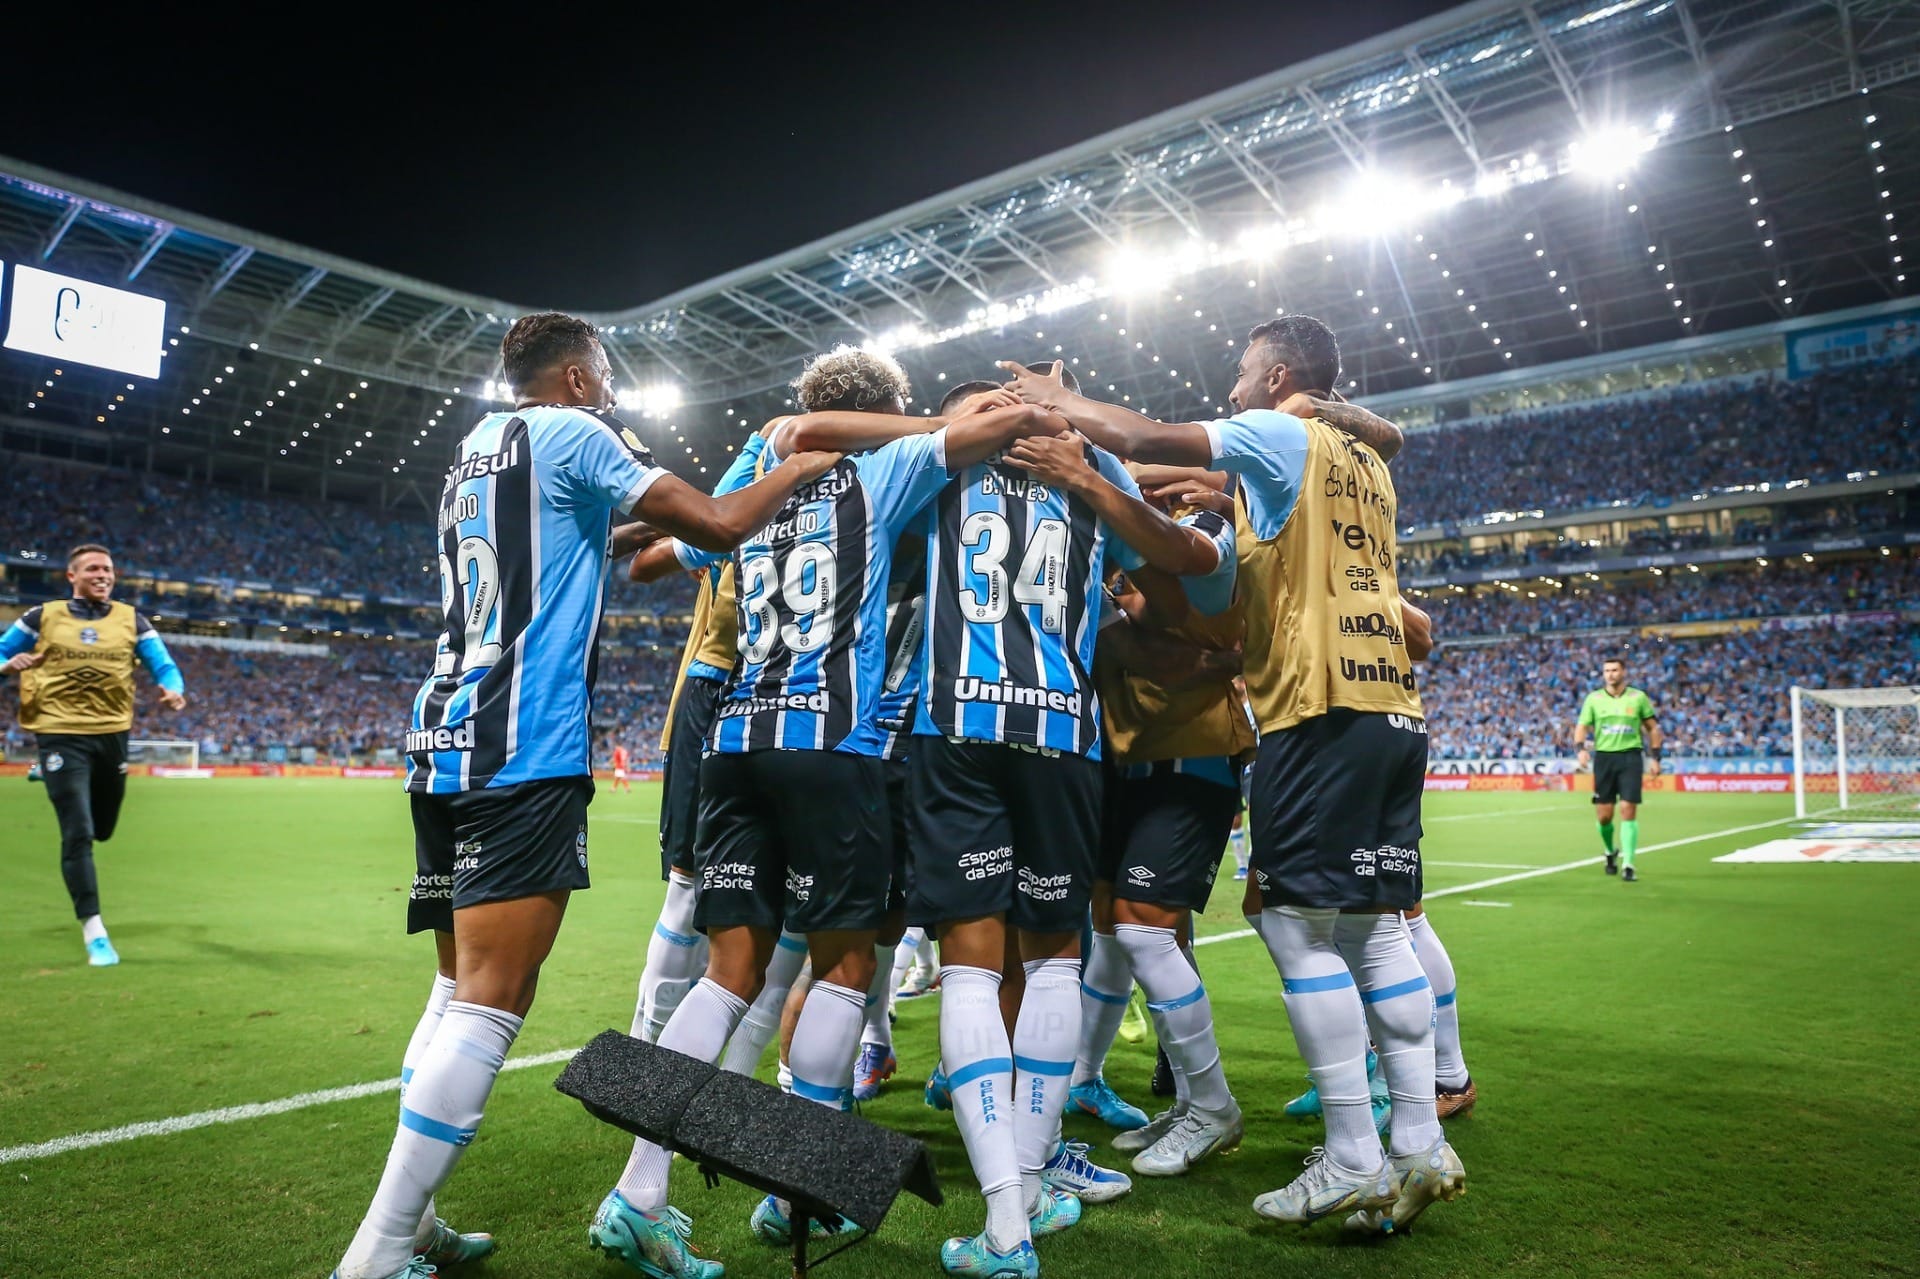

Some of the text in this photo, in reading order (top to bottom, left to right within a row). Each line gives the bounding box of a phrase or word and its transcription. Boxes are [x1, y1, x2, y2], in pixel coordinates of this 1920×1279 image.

[959, 511, 1069, 635] 34
[737, 541, 837, 664] 39
[954, 678, 1082, 717] Unimed
[1018, 866, 1072, 887] Esportes
[1127, 878, 1151, 888] umbro
